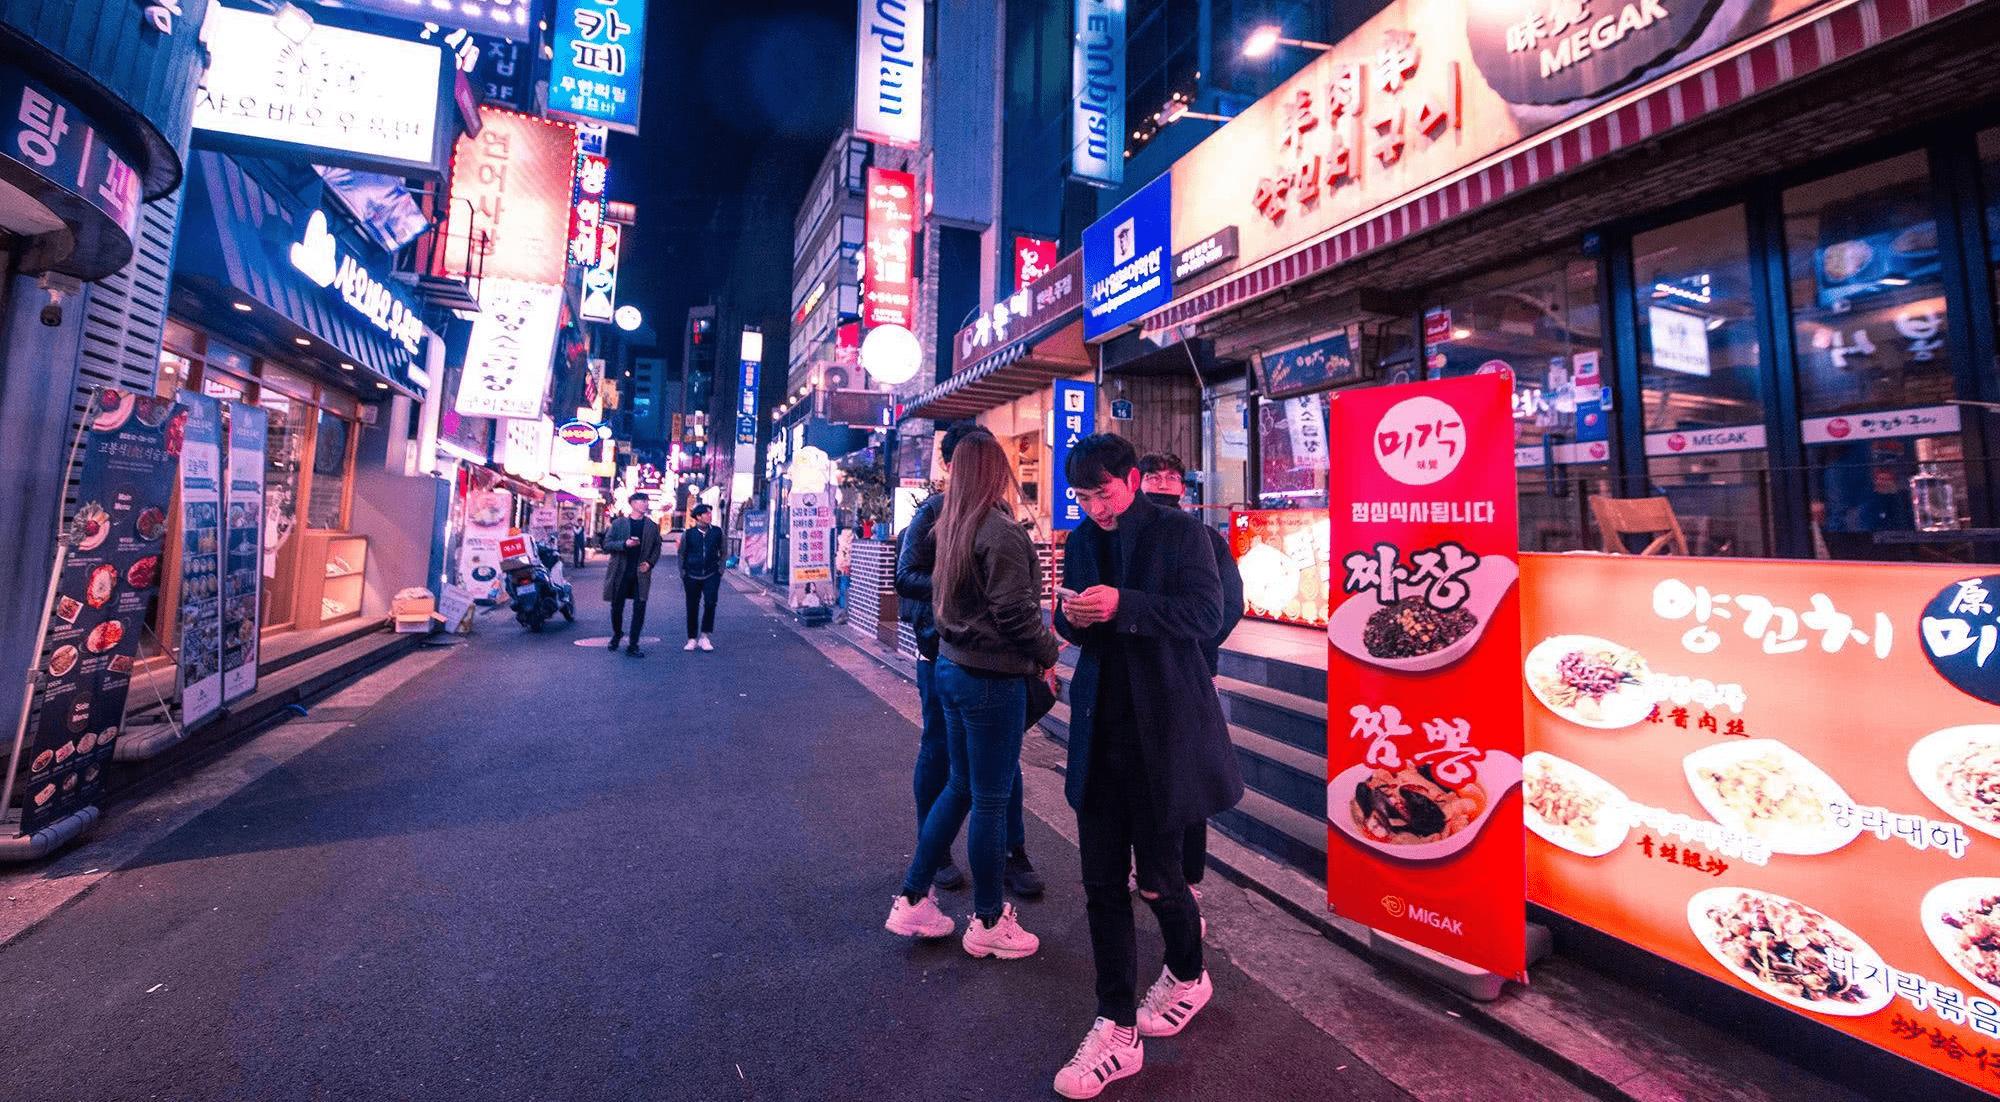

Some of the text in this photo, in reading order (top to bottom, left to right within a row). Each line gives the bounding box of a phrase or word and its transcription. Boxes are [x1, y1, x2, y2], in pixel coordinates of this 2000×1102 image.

[571, 0, 630, 75] 카페
[1540, 0, 1668, 78] MEGAK
[17, 86, 69, 167] 탕
[1378, 420, 1460, 459] 미각
[1351, 501, 1495, 523] 점심식사됩니다
[1345, 543, 1479, 611] 짜장
[1653, 579, 1893, 659] 양꼬치
[1922, 616, 2000, 668] 미
[1350, 705, 1482, 784] 짬뽕
[1408, 903, 1463, 936] MIGAK
